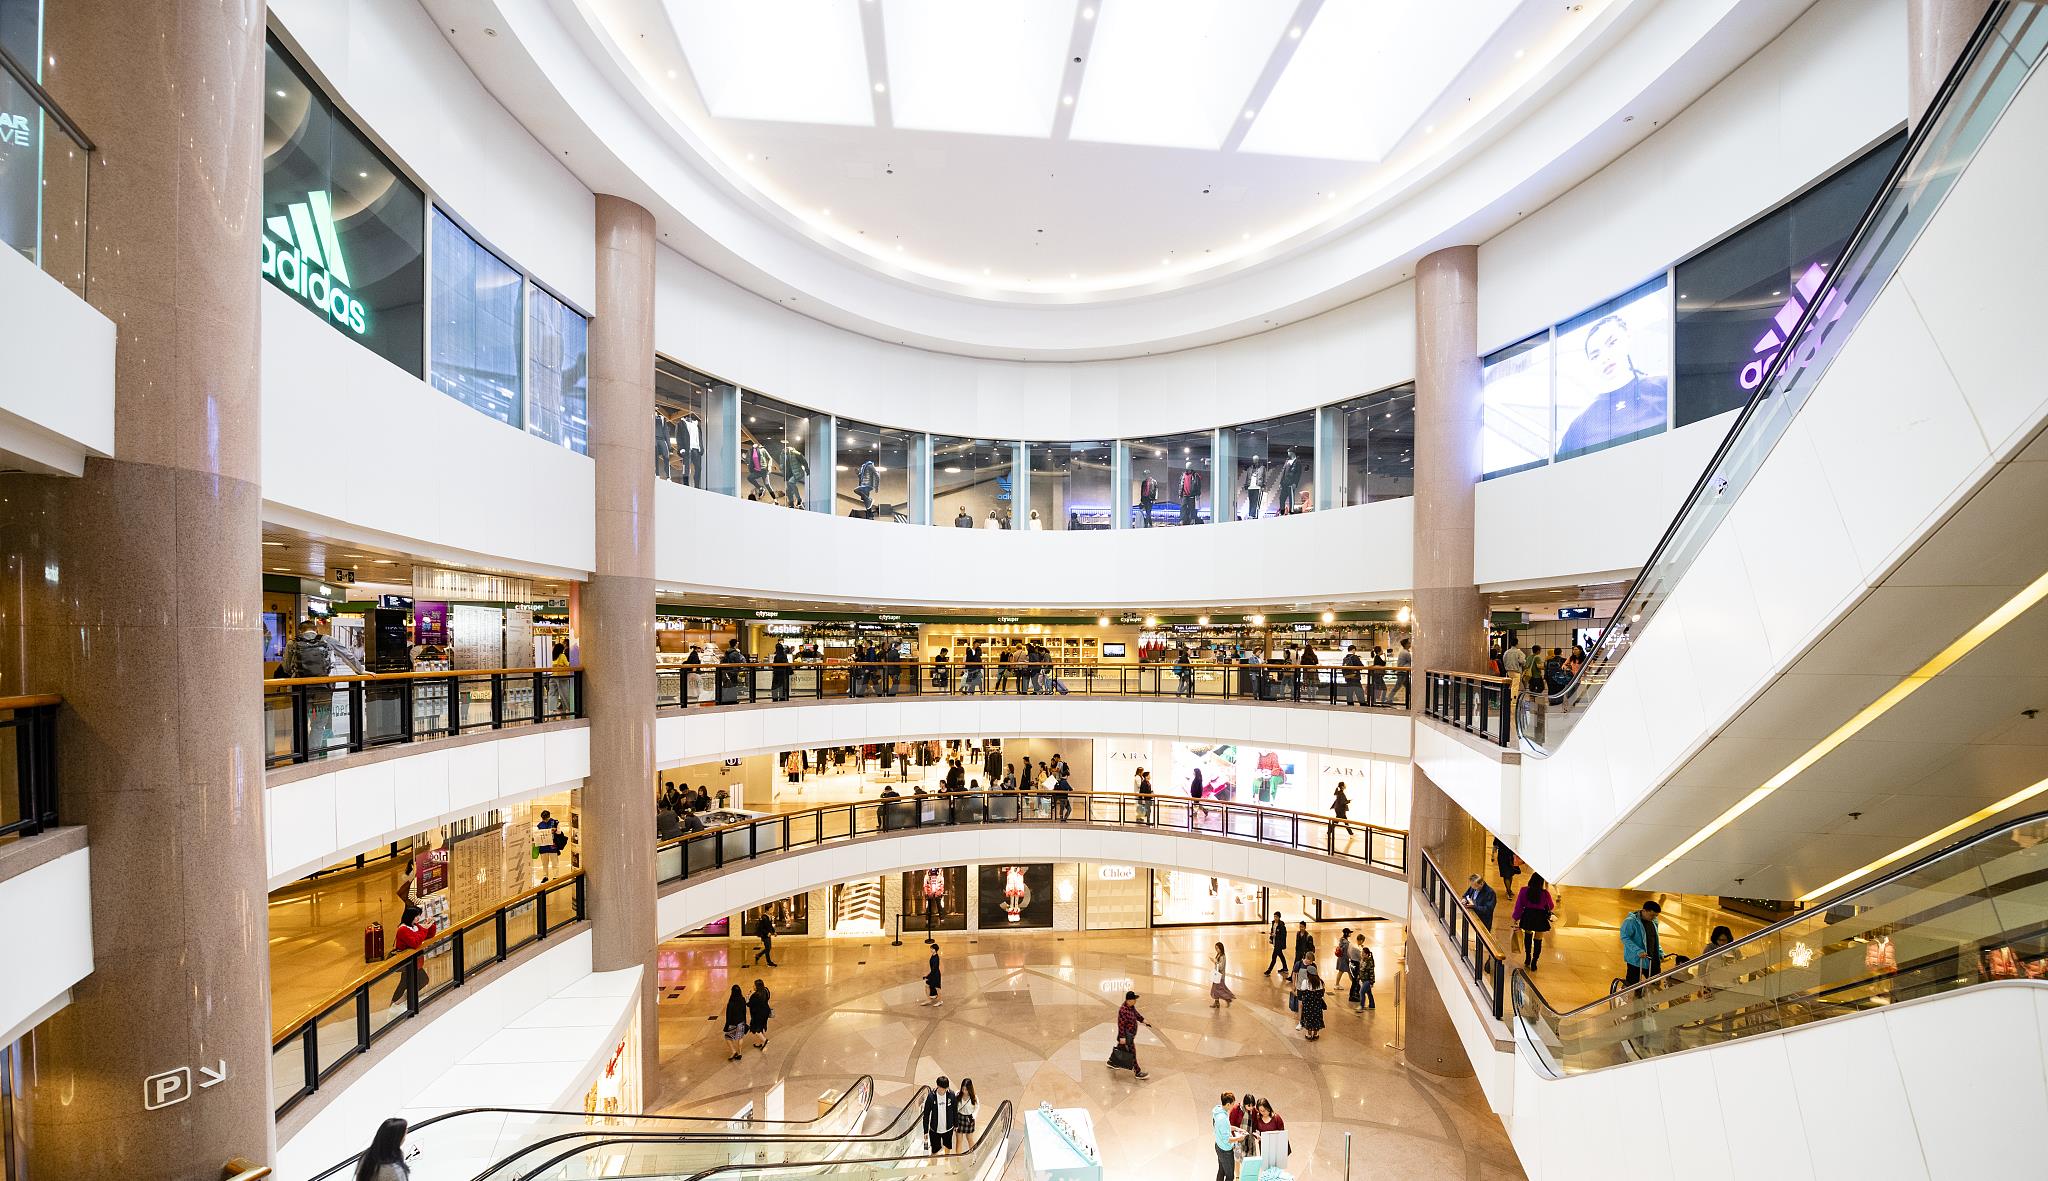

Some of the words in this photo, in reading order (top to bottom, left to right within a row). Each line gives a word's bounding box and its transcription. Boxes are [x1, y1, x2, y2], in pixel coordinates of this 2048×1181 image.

[767, 624, 802, 634] Cashier
[1322, 765, 1365, 777] ZARA
[157, 1075, 181, 1104] P
